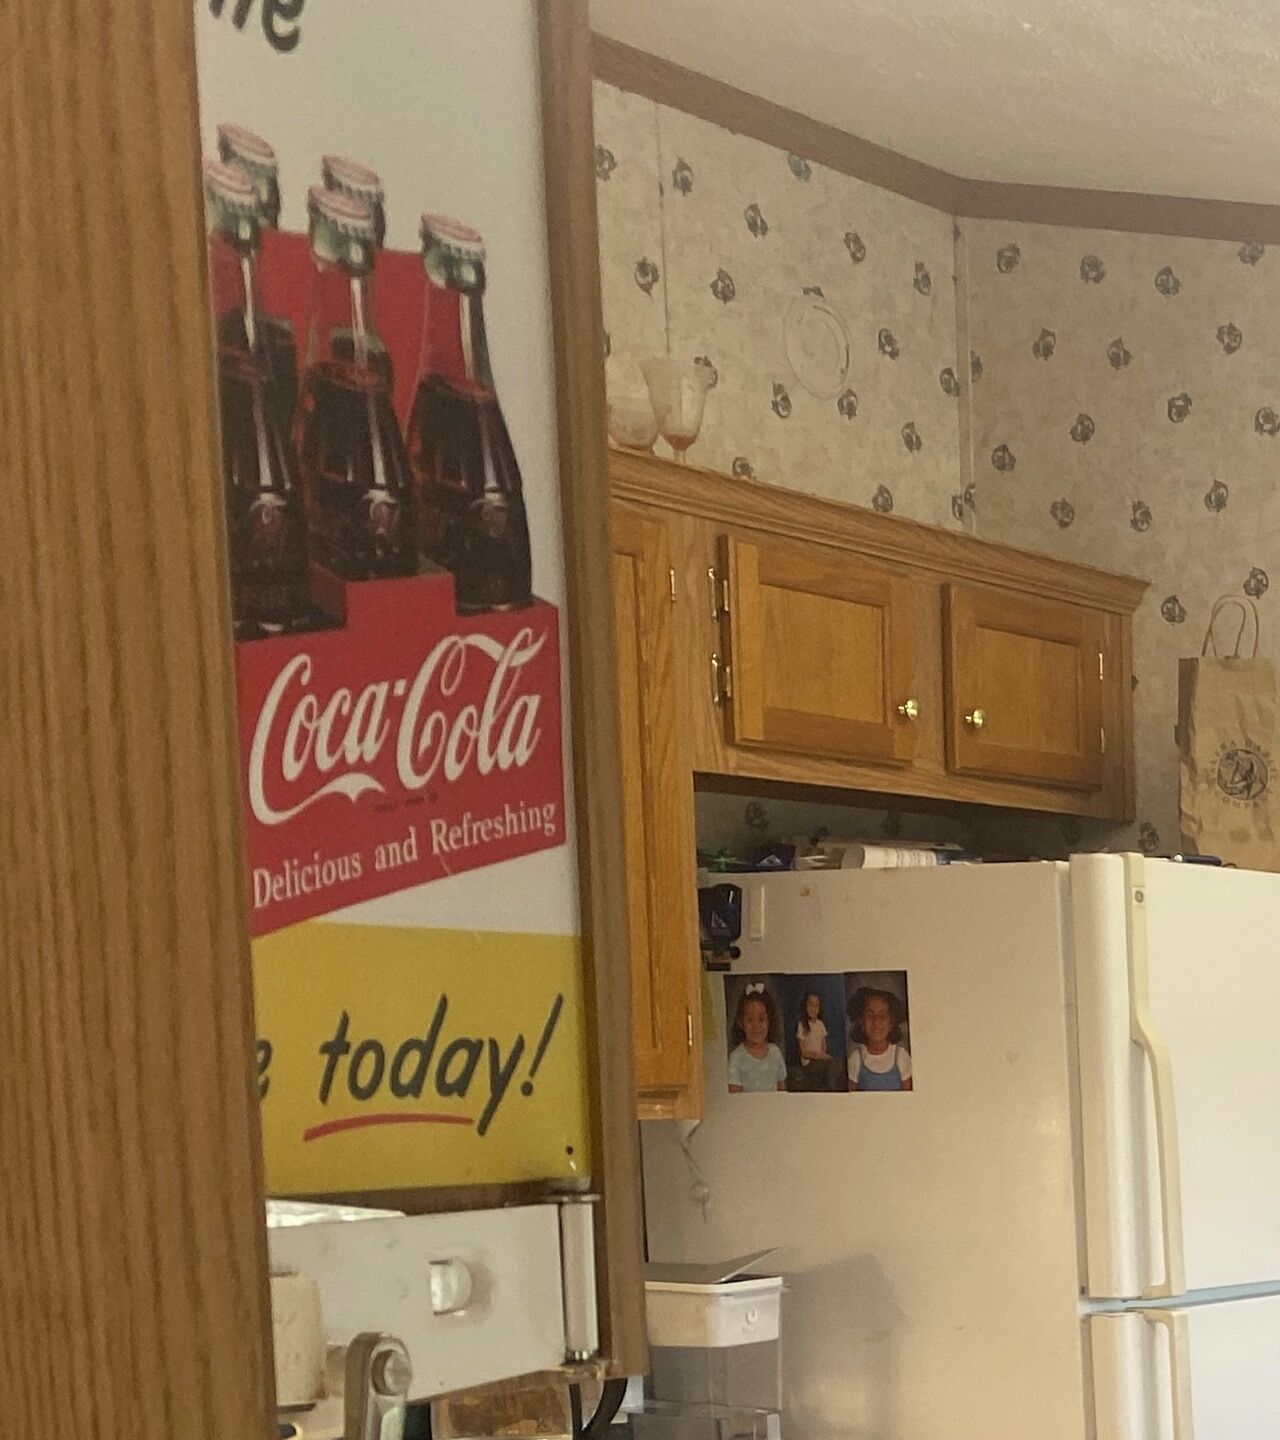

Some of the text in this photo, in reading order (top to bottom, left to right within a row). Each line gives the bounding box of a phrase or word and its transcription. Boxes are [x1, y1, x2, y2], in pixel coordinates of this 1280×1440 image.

[250, 628, 547, 820] Coca-Cola
[253, 803, 557, 909] Delicious and Refreshing
[318, 993, 564, 1137] today!
